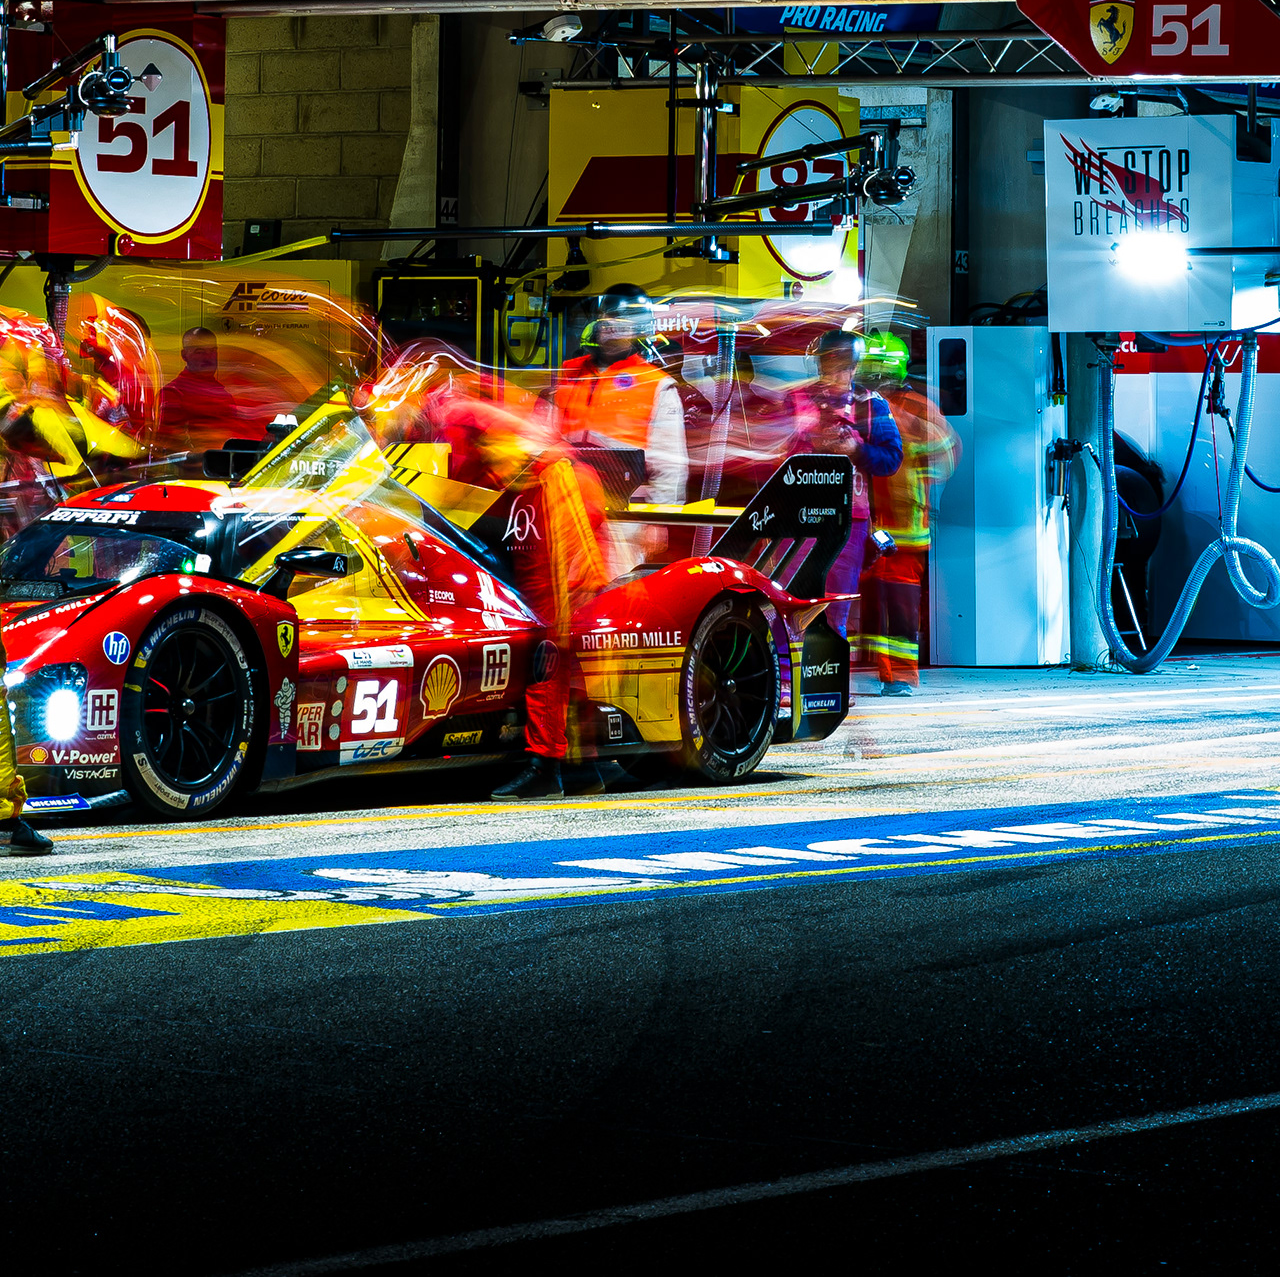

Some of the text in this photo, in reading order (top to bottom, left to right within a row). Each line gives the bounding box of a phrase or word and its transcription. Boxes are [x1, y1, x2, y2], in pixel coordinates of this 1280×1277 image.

[779, 6, 888, 33] PRO RACING
[1151, 4, 1230, 56] 51
[96, 96, 198, 177] 51
[1073, 150, 1191, 195] WE STOP
[1073, 198, 1190, 236] BREACHES
[955, 253, 969, 271] 43
[289, 460, 326, 476] ADLER
[796, 469, 846, 485] Santander
[41, 507, 142, 525] Ferrari
[434, 589, 455, 602] ECOPOL
[150, 608, 196, 647] MICHELIN
[106, 633, 129, 665] hp
[582, 630, 682, 651] RICHARD MILLE
[802, 659, 841, 678] VISTAJET
[688, 655, 697, 725] MICHELIN
[351, 679, 399, 734] 51
[807, 698, 837, 708] MICHELIN
[96, 730, 117, 741] azimut
[446, 731, 478, 746] Sabelt
[52, 748, 117, 765] V-Power
[352, 741, 393, 760] WEC
[64, 766, 118, 780] VISTAJET
[194, 760, 238, 807] MICHELIN
[30, 796, 80, 809] MICHELIN
